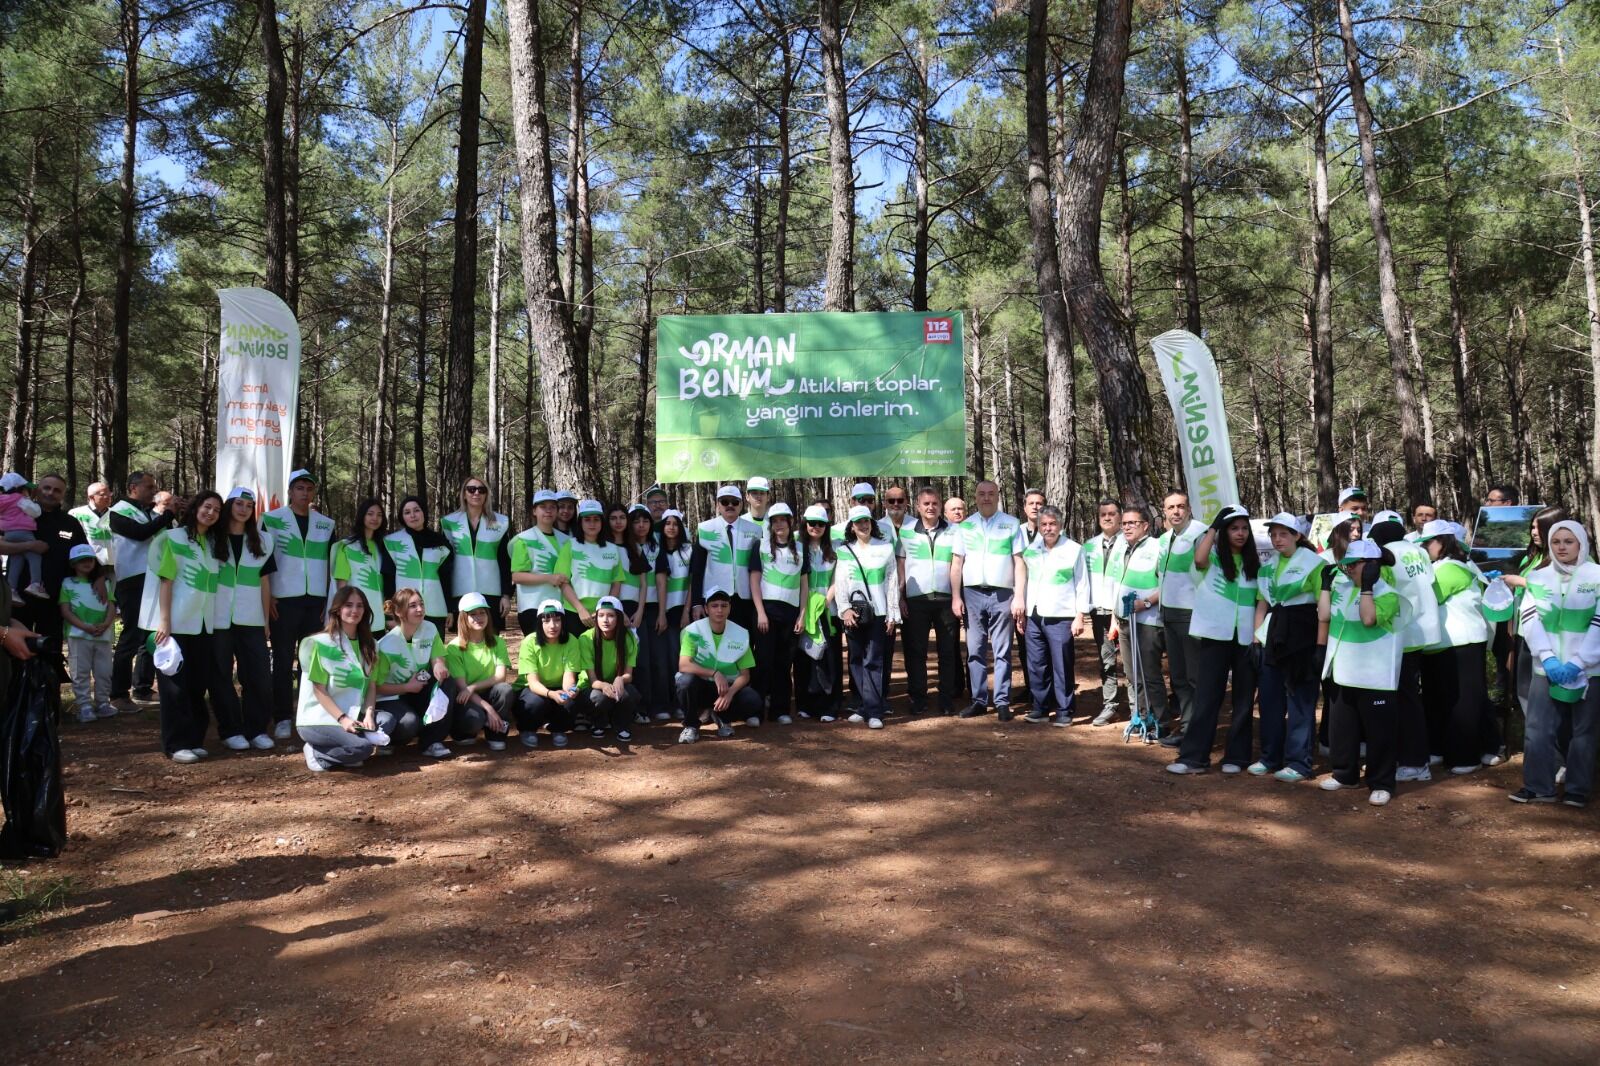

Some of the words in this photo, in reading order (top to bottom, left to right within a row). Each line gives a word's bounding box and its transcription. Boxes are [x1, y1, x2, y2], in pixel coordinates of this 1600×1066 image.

[927, 321, 948, 331] 112
[678, 332, 796, 367] ORMAN
[798, 376, 869, 394] Atıkları
[876, 374, 943, 396] toplar,
[746, 404, 823, 427] yangını
[829, 400, 919, 418] önlerim.
